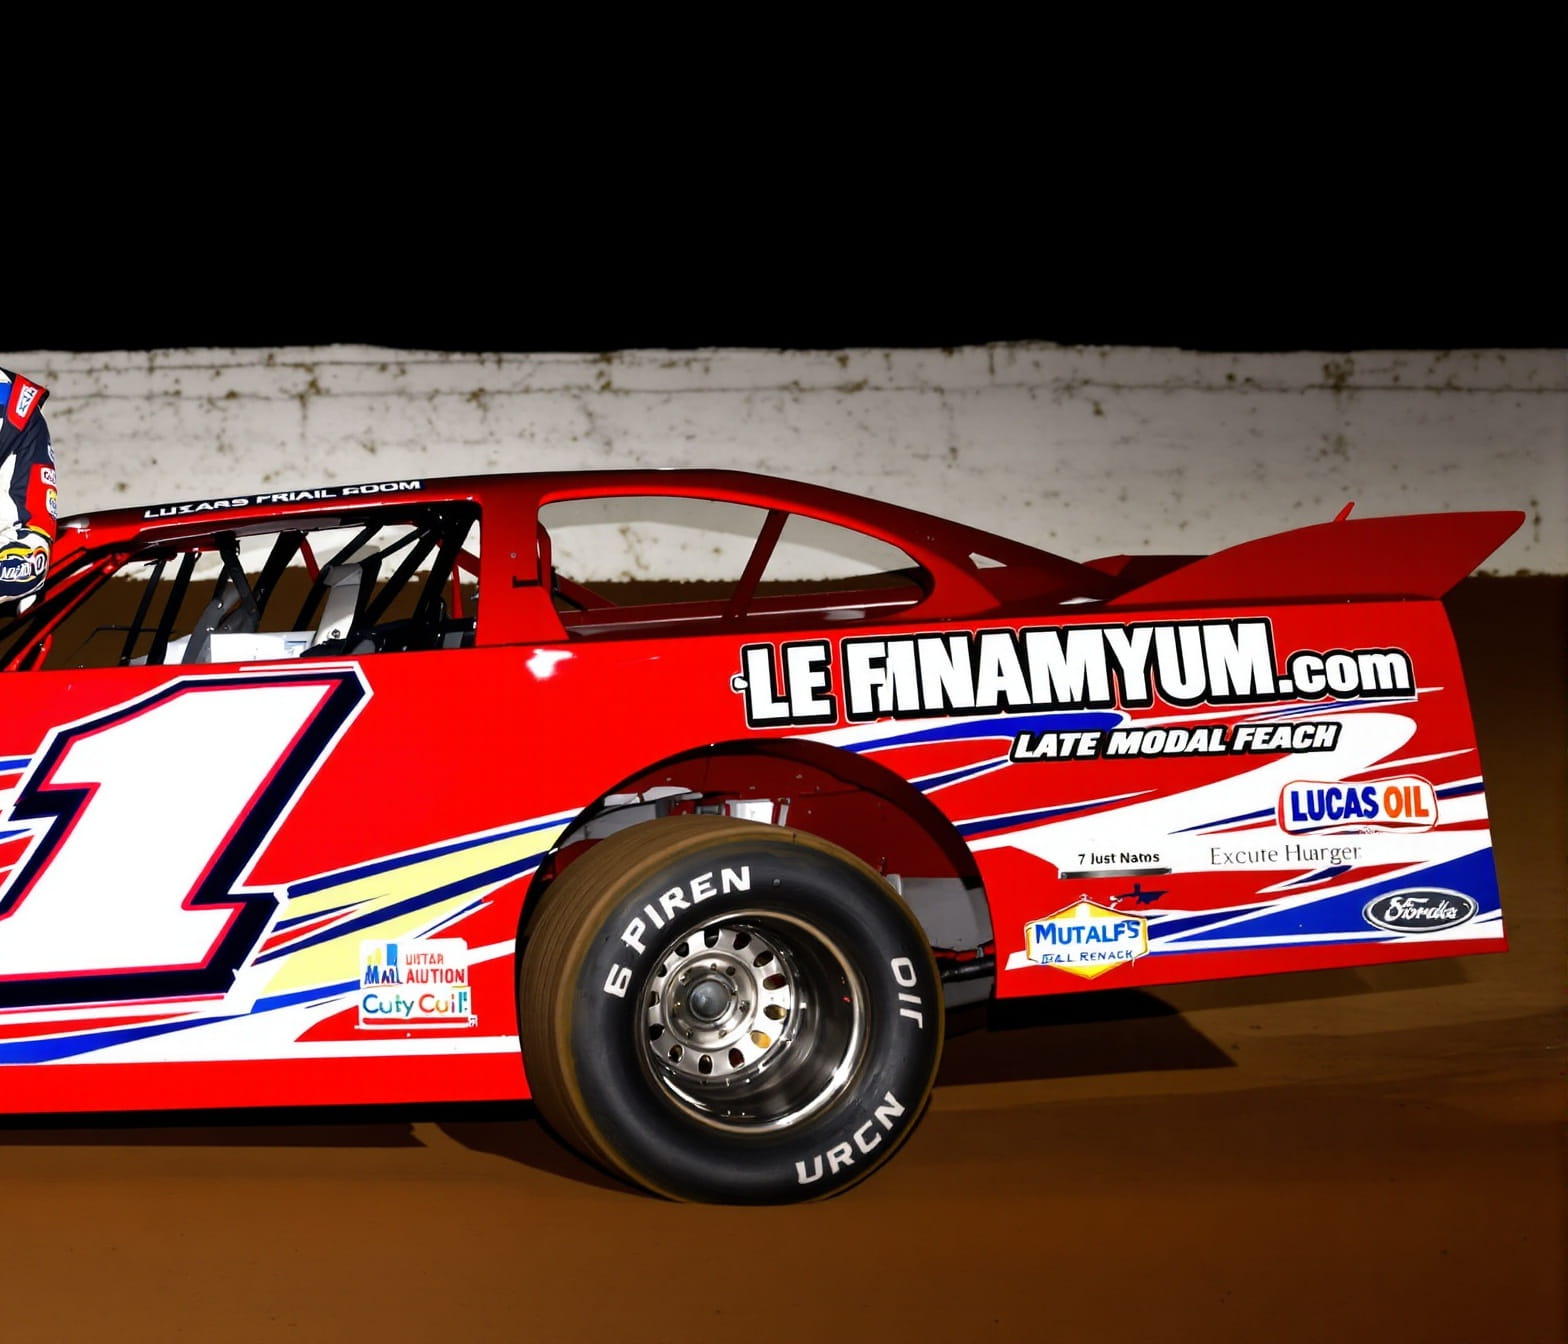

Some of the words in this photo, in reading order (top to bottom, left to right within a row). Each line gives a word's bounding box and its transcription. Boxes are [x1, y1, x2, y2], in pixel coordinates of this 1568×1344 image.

[1015, 732, 1098, 759] LATE
[1106, 727, 1228, 755] MODAL
[1233, 724, 1338, 750] FEACH
[1290, 786, 1379, 821] LUCAS
[1383, 786, 1430, 819] OIL
